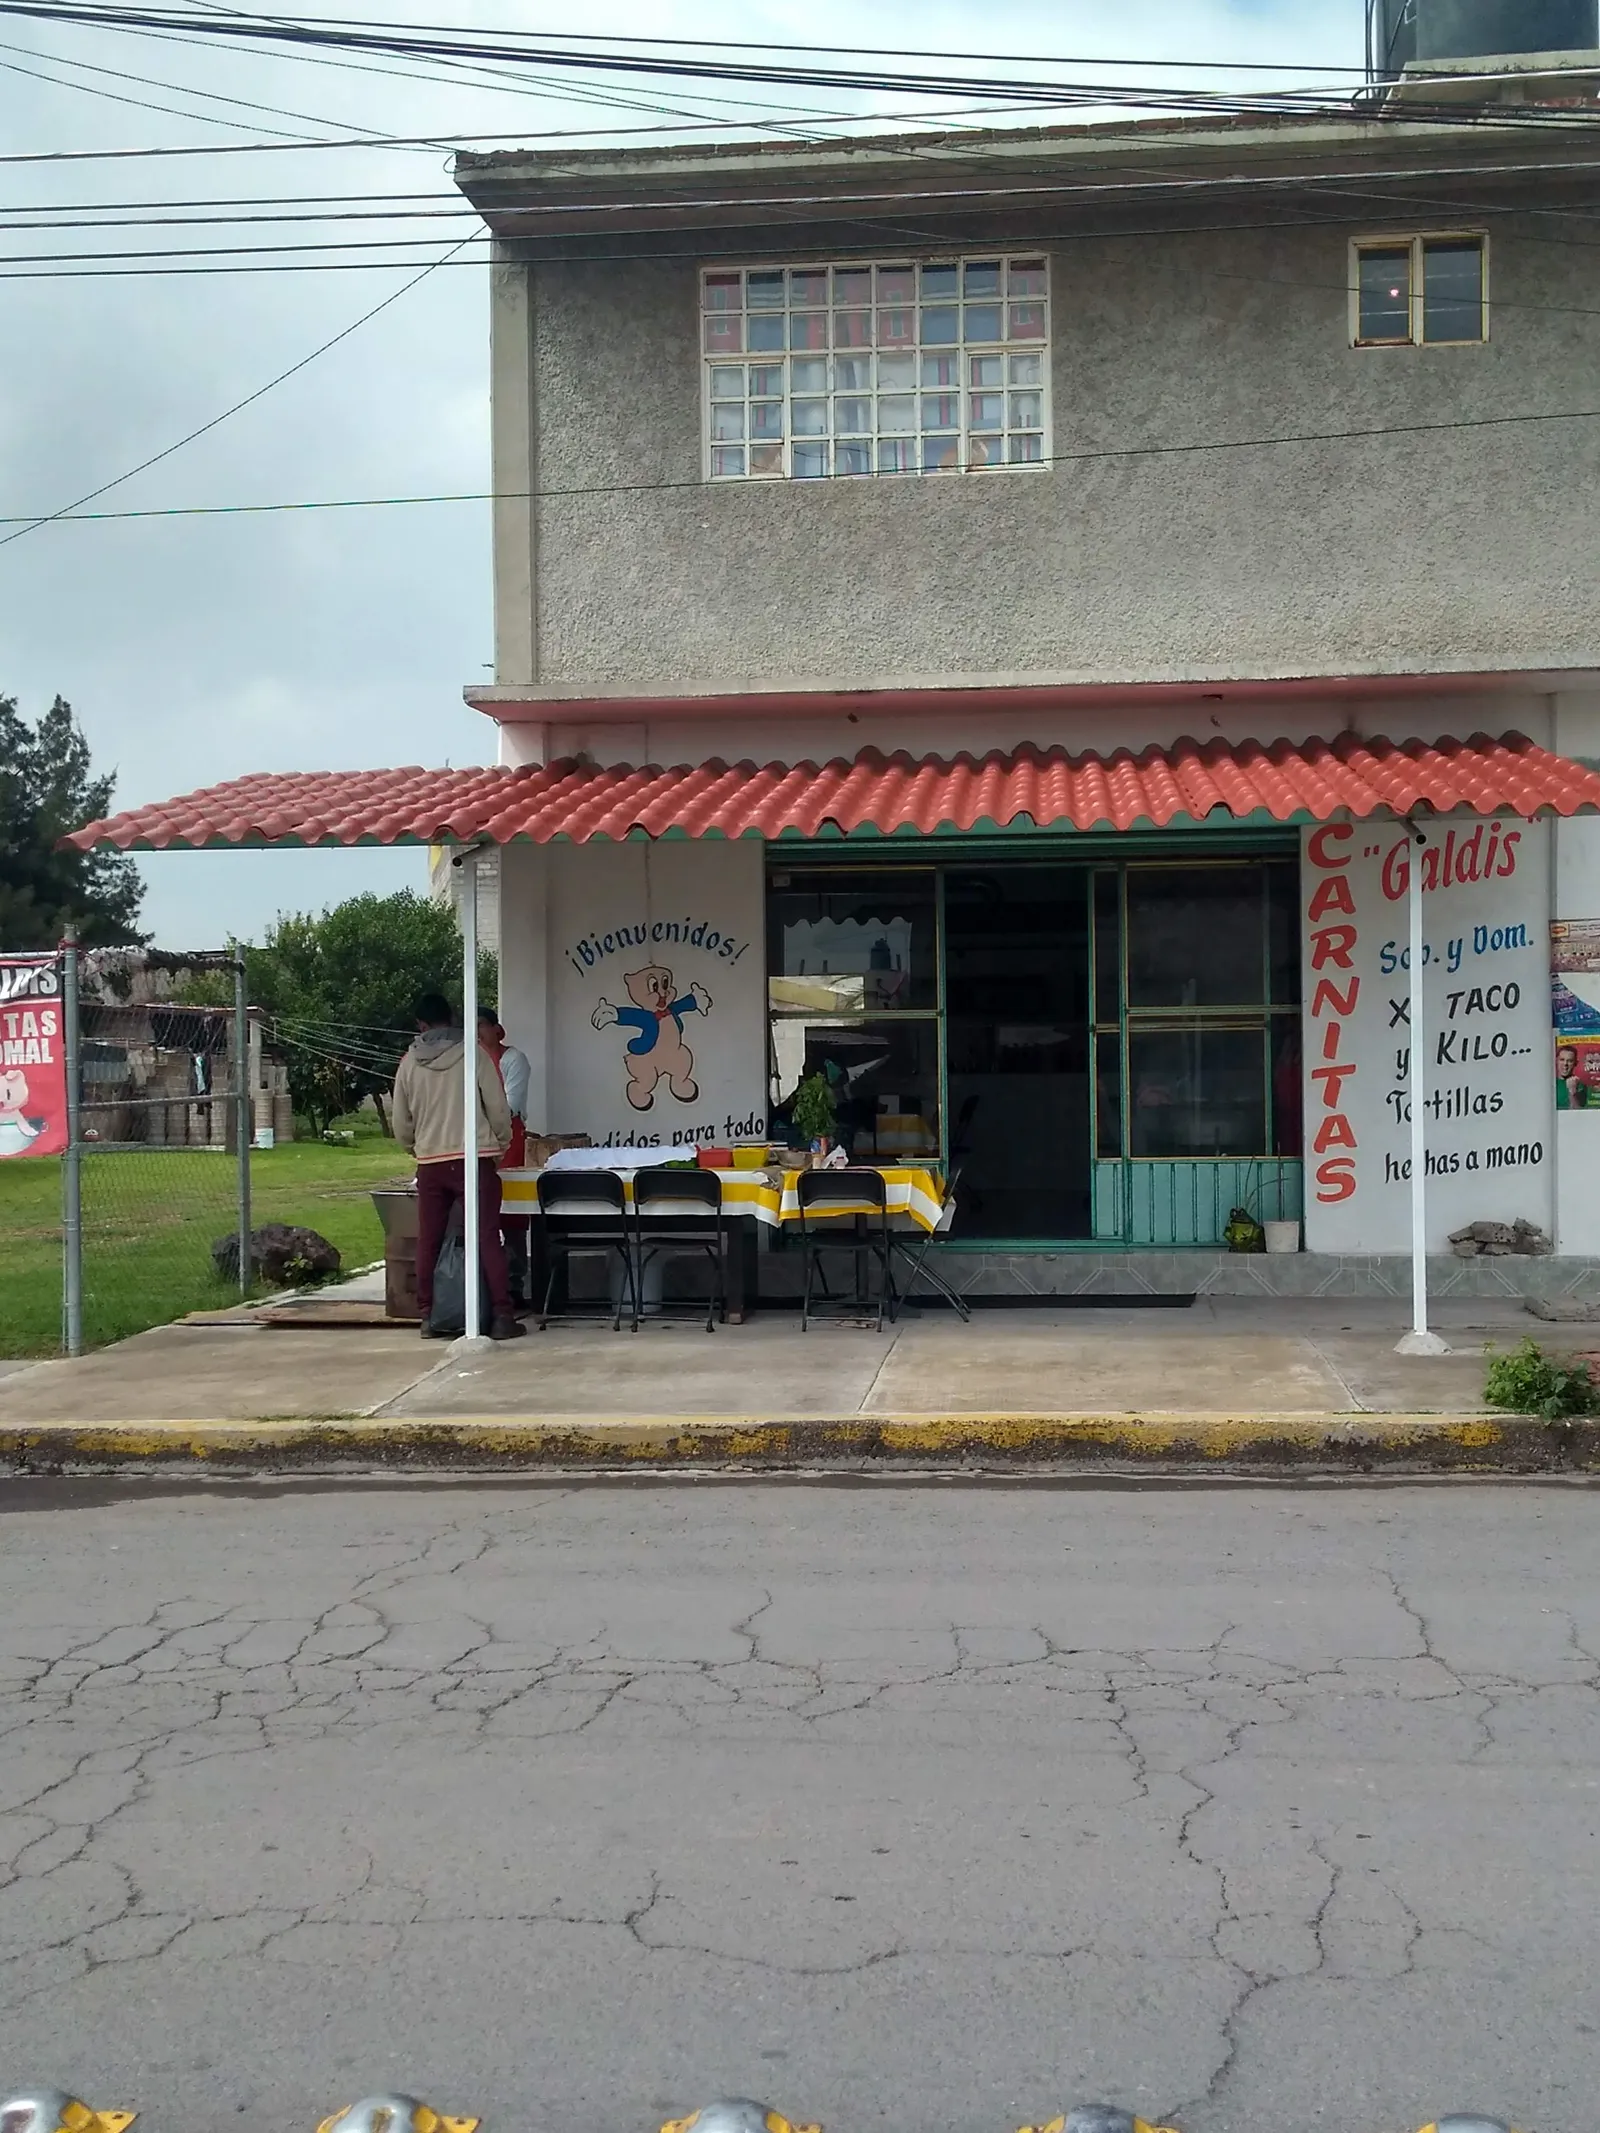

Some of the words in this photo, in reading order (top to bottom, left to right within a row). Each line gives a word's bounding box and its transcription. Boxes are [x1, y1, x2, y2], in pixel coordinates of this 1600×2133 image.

[1447, 938, 1463, 973] y
[1473, 923, 1535, 955] Dom.
[0, 963, 58, 1000] LDIS
[1308, 823, 1360, 1204] CARNITAS
[1446, 982, 1520, 1020] TACO
[0, 1010, 57, 1038] TAS
[0, 1038, 54, 1066] MAL
[672, 1122, 715, 1148] para
[723, 1112, 764, 1138] todo
[1385, 1149, 1460, 1184] hehas
[1466, 1149, 1480, 1171] a
[1486, 1140, 1543, 1168] mano
